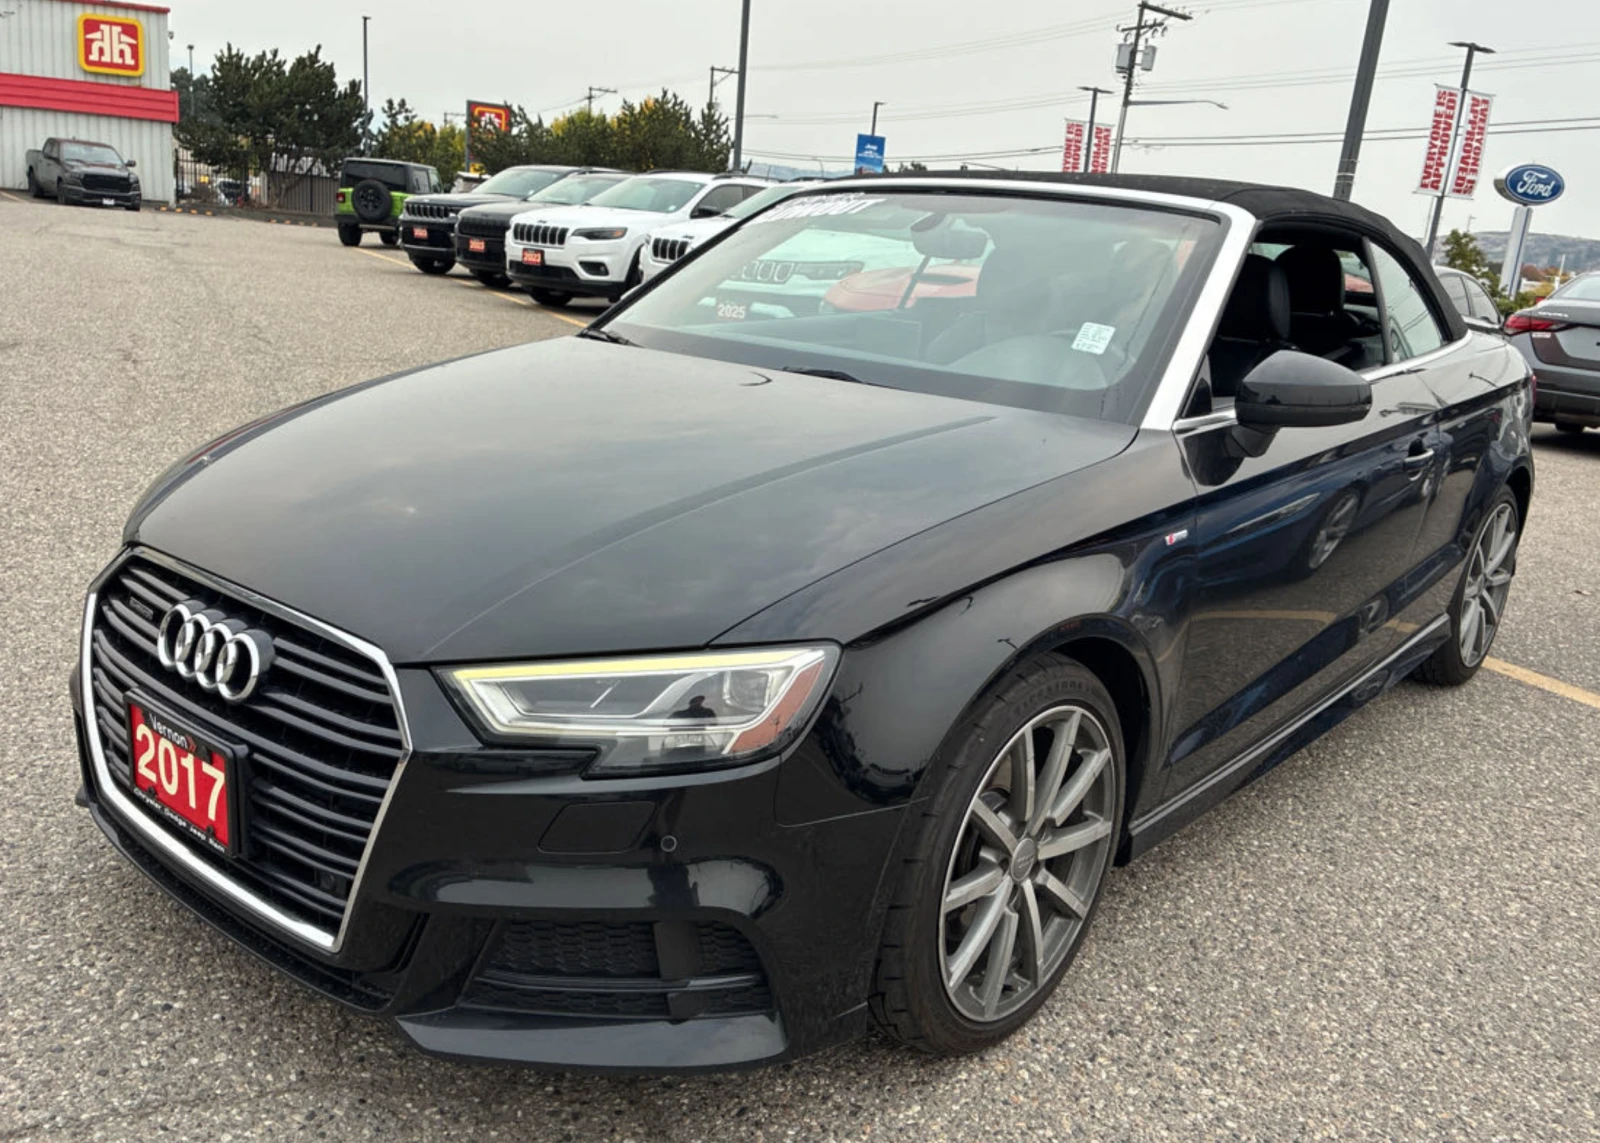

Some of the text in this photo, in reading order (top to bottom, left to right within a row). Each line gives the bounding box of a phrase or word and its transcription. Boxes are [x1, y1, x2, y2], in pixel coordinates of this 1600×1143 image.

[1420, 90, 1447, 189] EVERYONE IS
[1430, 91, 1458, 190] APPROVED!
[1452, 96, 1480, 193] APPROVED!
[1463, 98, 1490, 194] EVERYONE IS
[1517, 170, 1556, 197] Ford
[717, 303, 746, 319] 2025
[135, 723, 225, 822] 2017
[148, 712, 188, 750] Vernon
